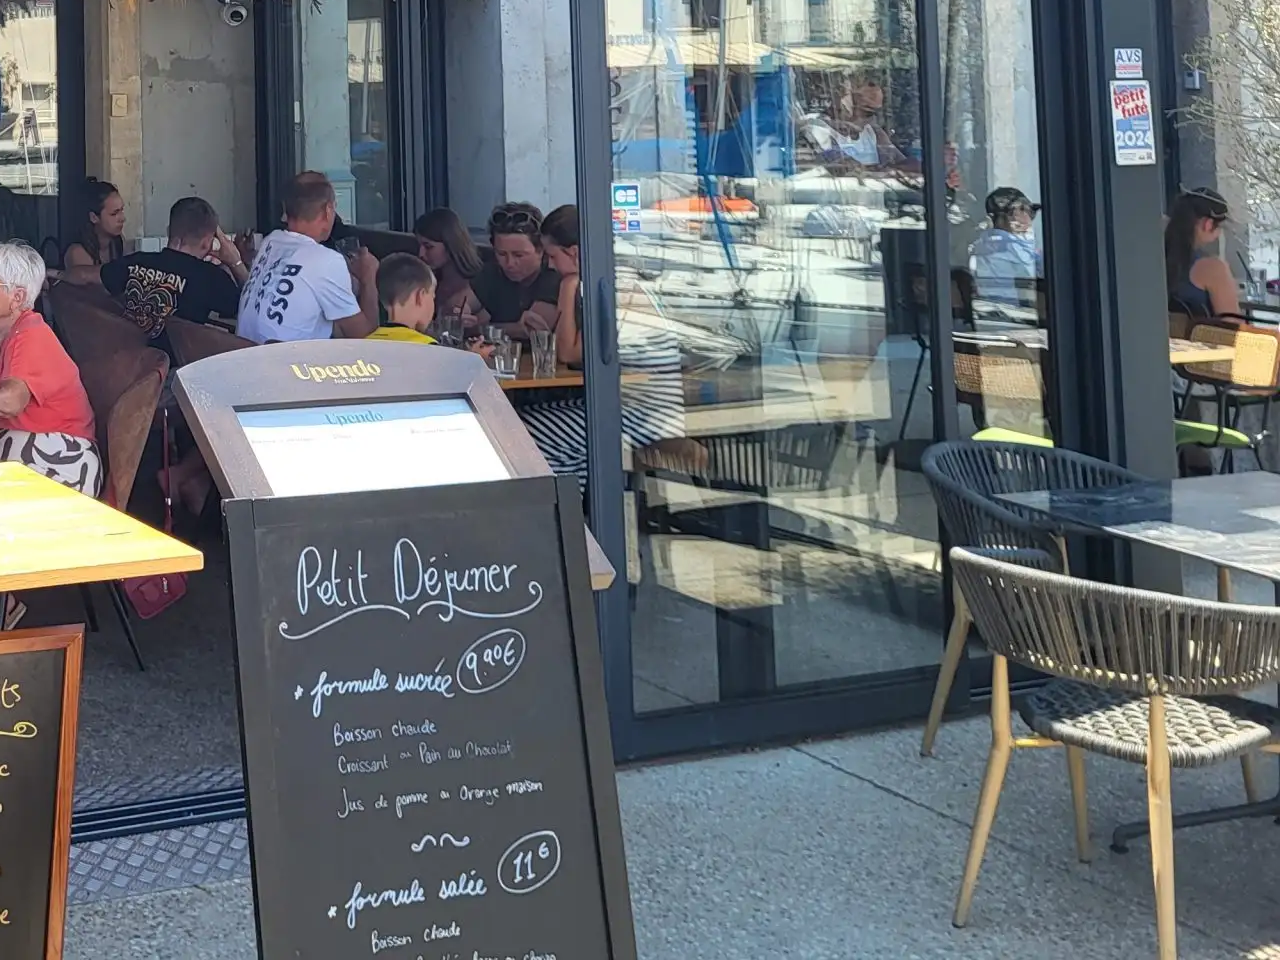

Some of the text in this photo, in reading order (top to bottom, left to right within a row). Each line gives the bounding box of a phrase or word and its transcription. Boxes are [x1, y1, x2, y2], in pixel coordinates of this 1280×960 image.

[1114, 88, 1145, 108] petit
[267, 264, 303, 326] BOSS
[290, 359, 381, 383] Upendo
[324, 411, 384, 427] Upendo
[297, 545, 369, 616] Petit
[310, 668, 389, 718] formule
[395, 657, 455, 697] sucrée
[333, 719, 437, 747] Boisson chaude
[338, 756, 389, 774] Croissant
[420, 742, 441, 765] Pain
[448, 747, 462, 760] au
[465, 740, 513, 758] Chocolat
[337, 787, 365, 818] Jus
[374, 794, 389, 809] de
[395, 790, 429, 818] pomme
[459, 785, 499, 806] Orange
[506, 779, 544, 795] maison
[345, 870, 488, 930] formule salée
[372, 921, 461, 954] Boisson chaude
